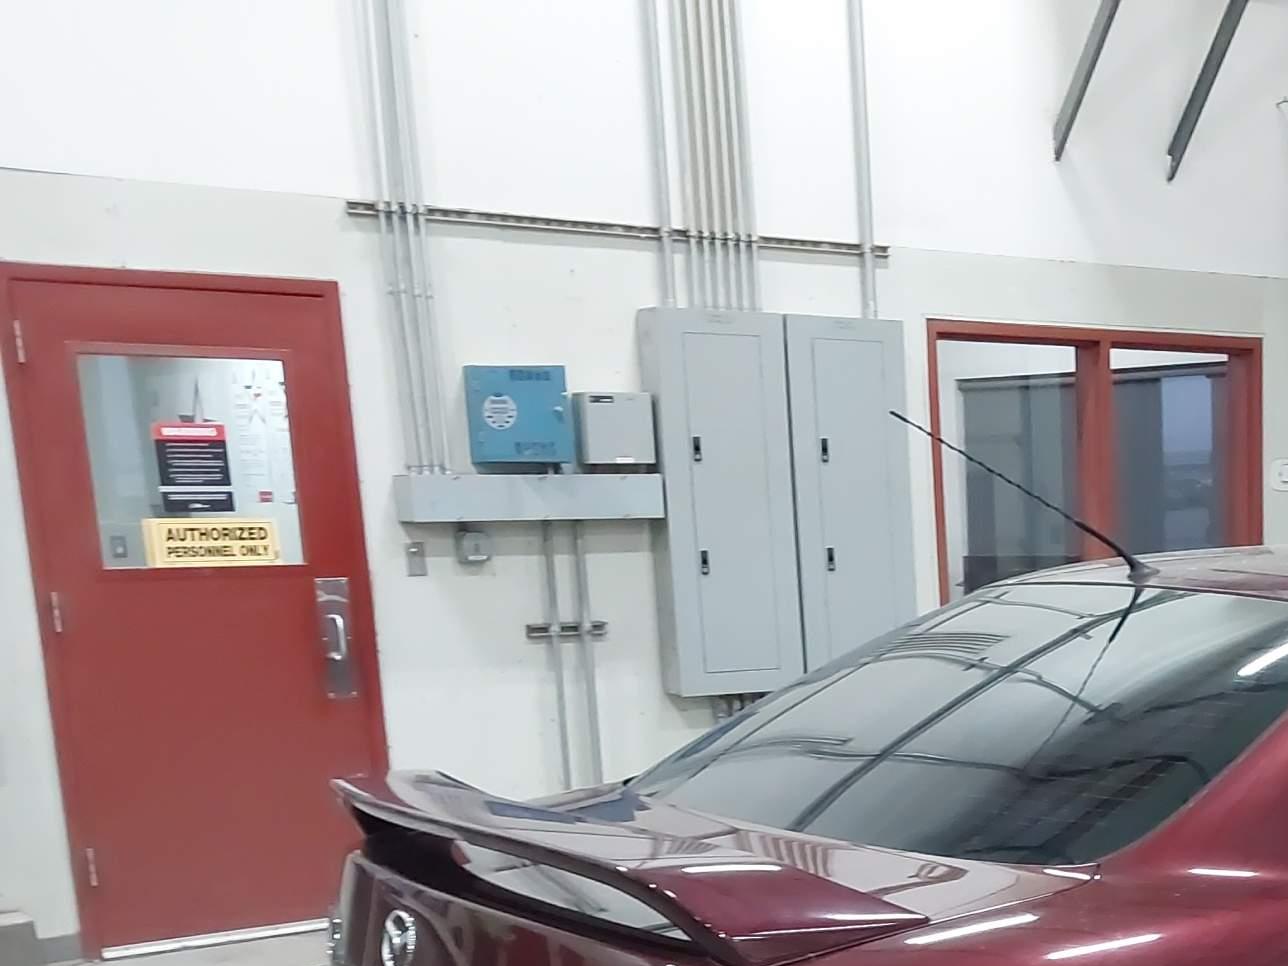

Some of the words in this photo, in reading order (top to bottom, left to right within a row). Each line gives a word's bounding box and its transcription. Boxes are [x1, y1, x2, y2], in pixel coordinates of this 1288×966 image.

[166, 526, 268, 542] AUTHORIZED
[166, 544, 236, 558] PERSONNEL
[239, 544, 270, 557] ONLY
